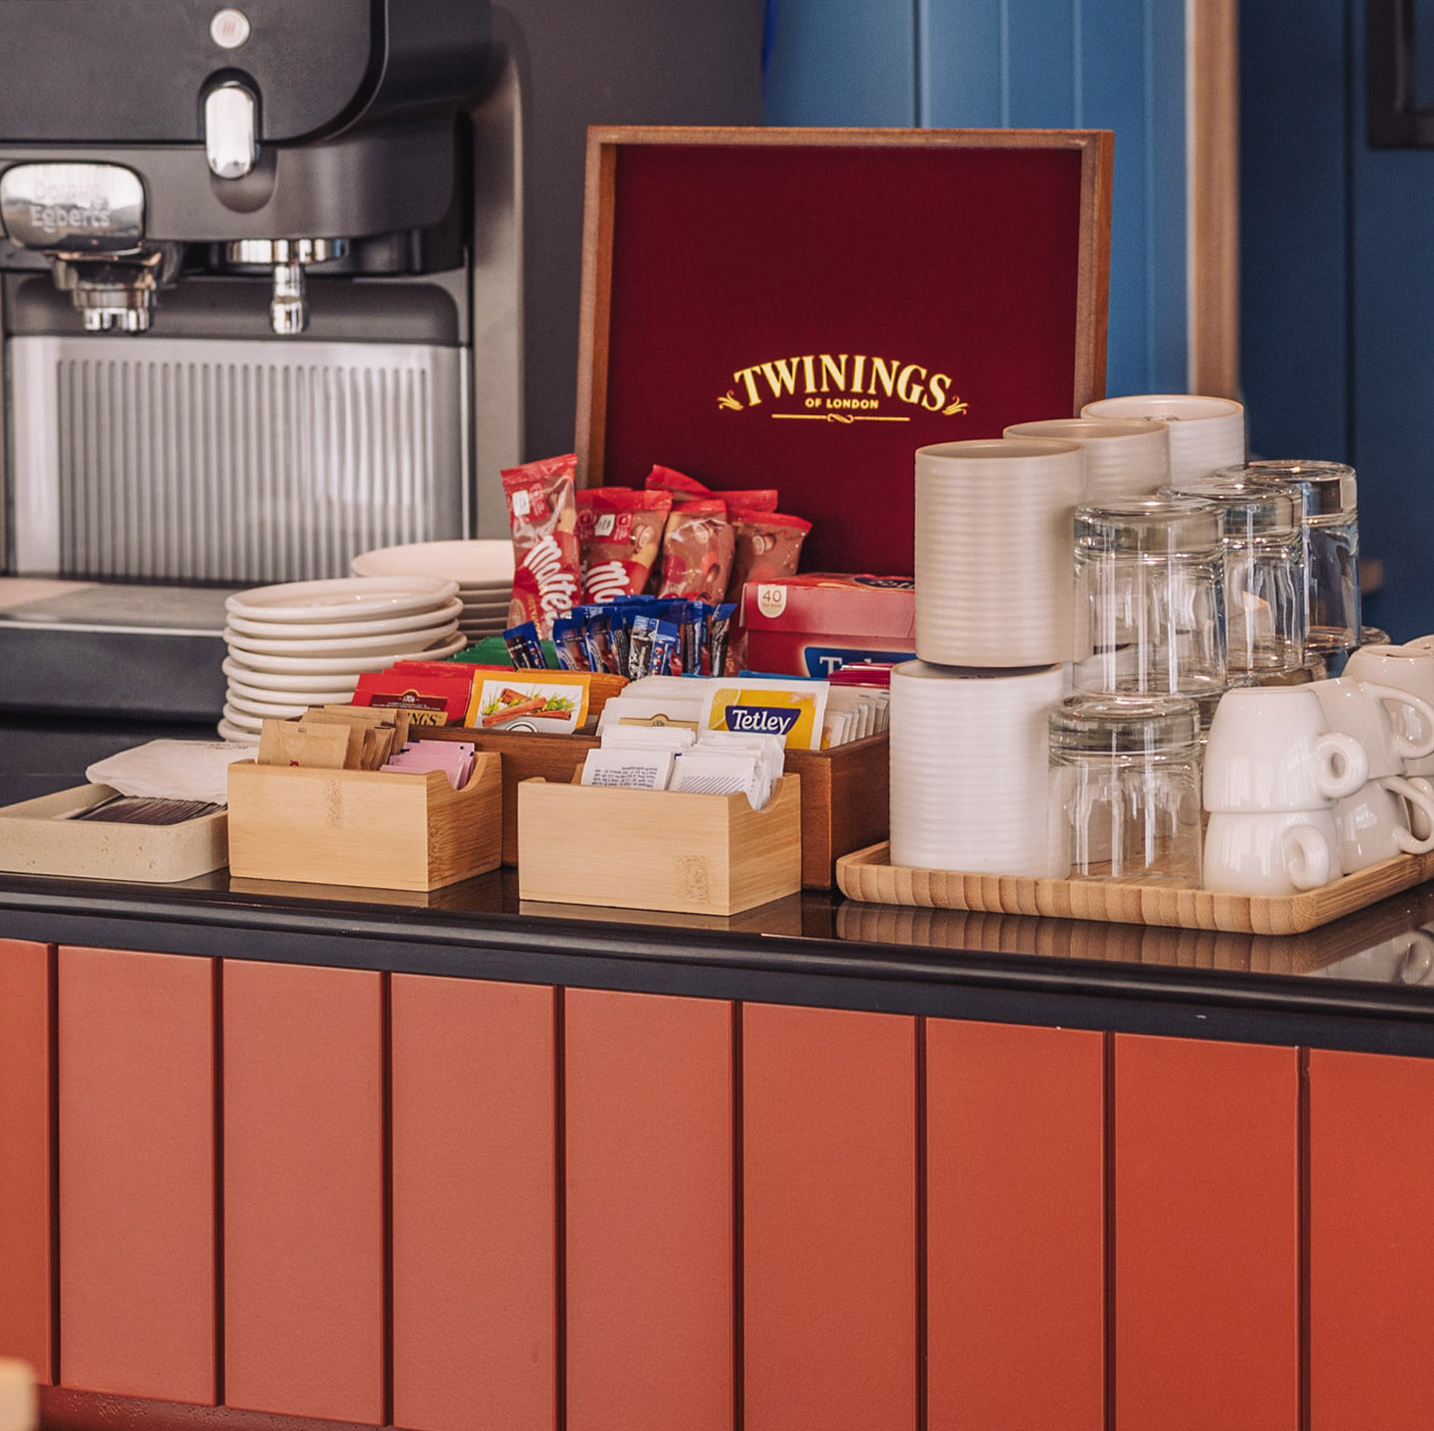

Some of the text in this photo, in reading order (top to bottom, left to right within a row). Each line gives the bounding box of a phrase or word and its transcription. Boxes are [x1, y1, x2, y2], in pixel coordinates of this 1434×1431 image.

[733, 354, 953, 412] TWININGS
[804, 397, 879, 410] OF LONDON
[762, 589, 782, 604] 40
[731, 709, 792, 735] Tetley
